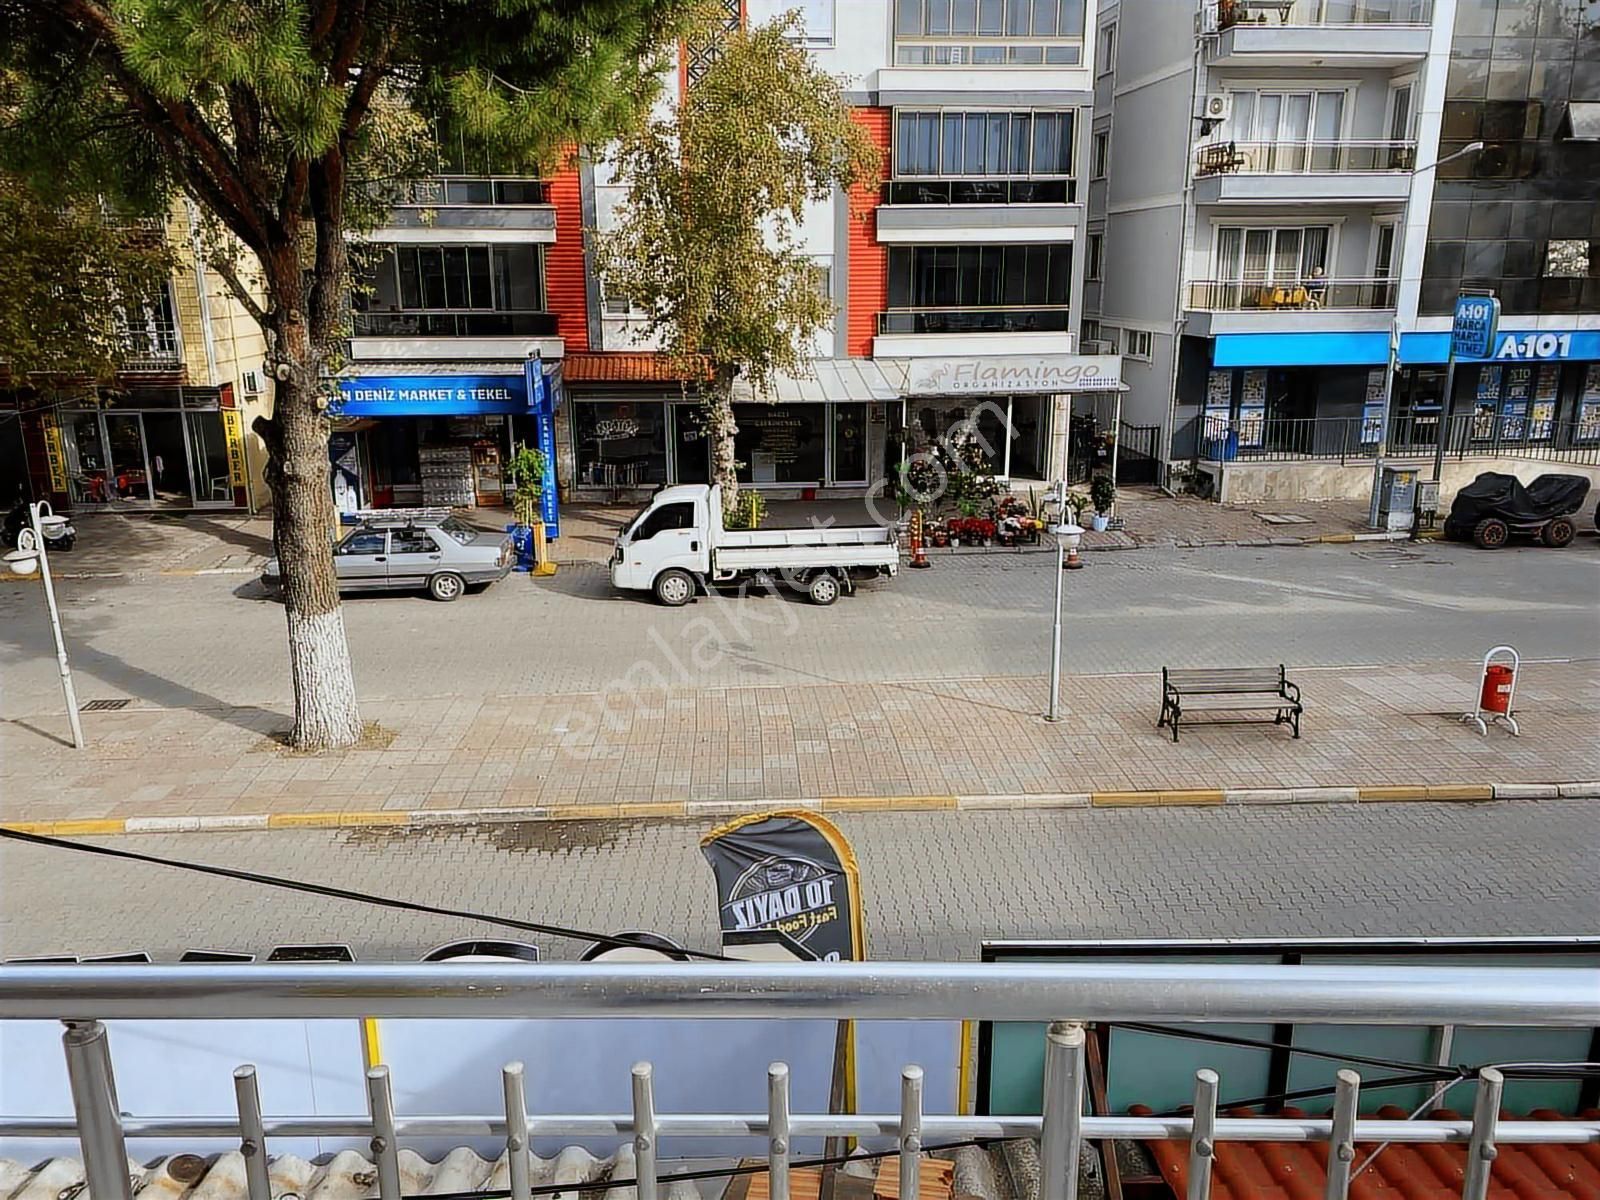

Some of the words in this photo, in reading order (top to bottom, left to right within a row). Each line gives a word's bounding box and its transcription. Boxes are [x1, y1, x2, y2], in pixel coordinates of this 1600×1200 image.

[355, 387, 396, 401] DENİZ
[398, 389, 454, 401] MARKET
[456, 389, 466, 400] &
[468, 389, 512, 400] TEKEL
[954, 361, 1100, 384] Flamingo
[44, 416, 62, 488] BERBER
[227, 415, 241, 482] BERBER
